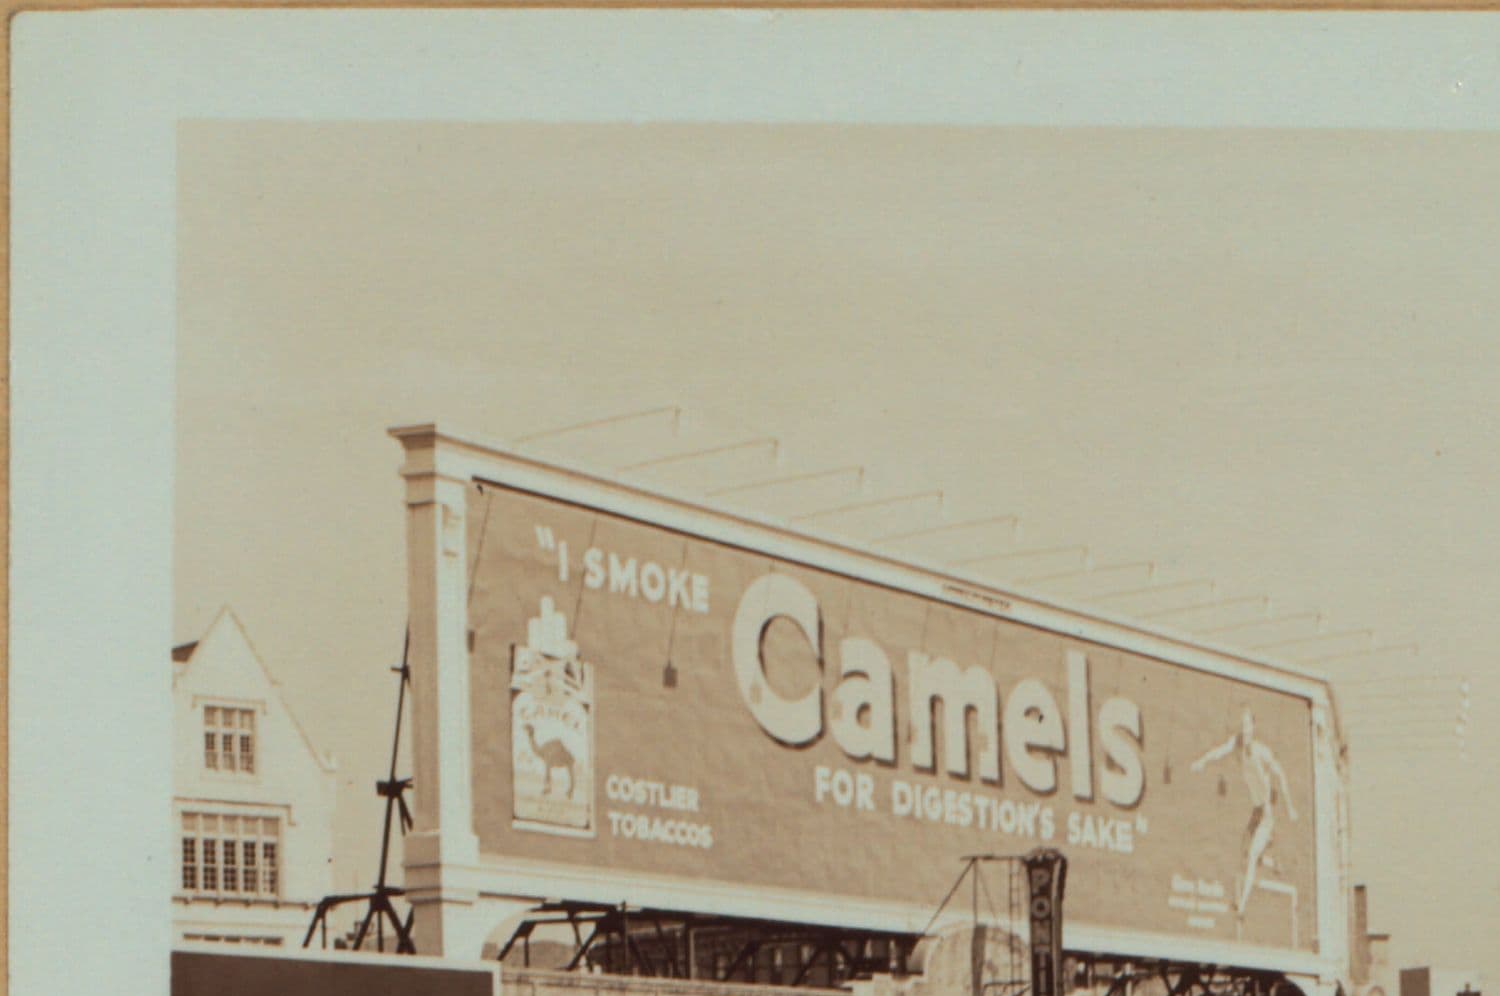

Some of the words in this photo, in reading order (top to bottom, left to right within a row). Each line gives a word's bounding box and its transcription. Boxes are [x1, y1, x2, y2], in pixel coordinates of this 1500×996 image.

[583, 547, 711, 615] SMOKE
[731, 572, 1147, 812] Camels
[605, 774, 700, 812] COSTLIER
[814, 766, 876, 811] FOR
[892, 779, 1055, 840] DIGESTION'S
[1066, 811, 1149, 854] SAKE"
[607, 812, 714, 850] TOBACCOS
